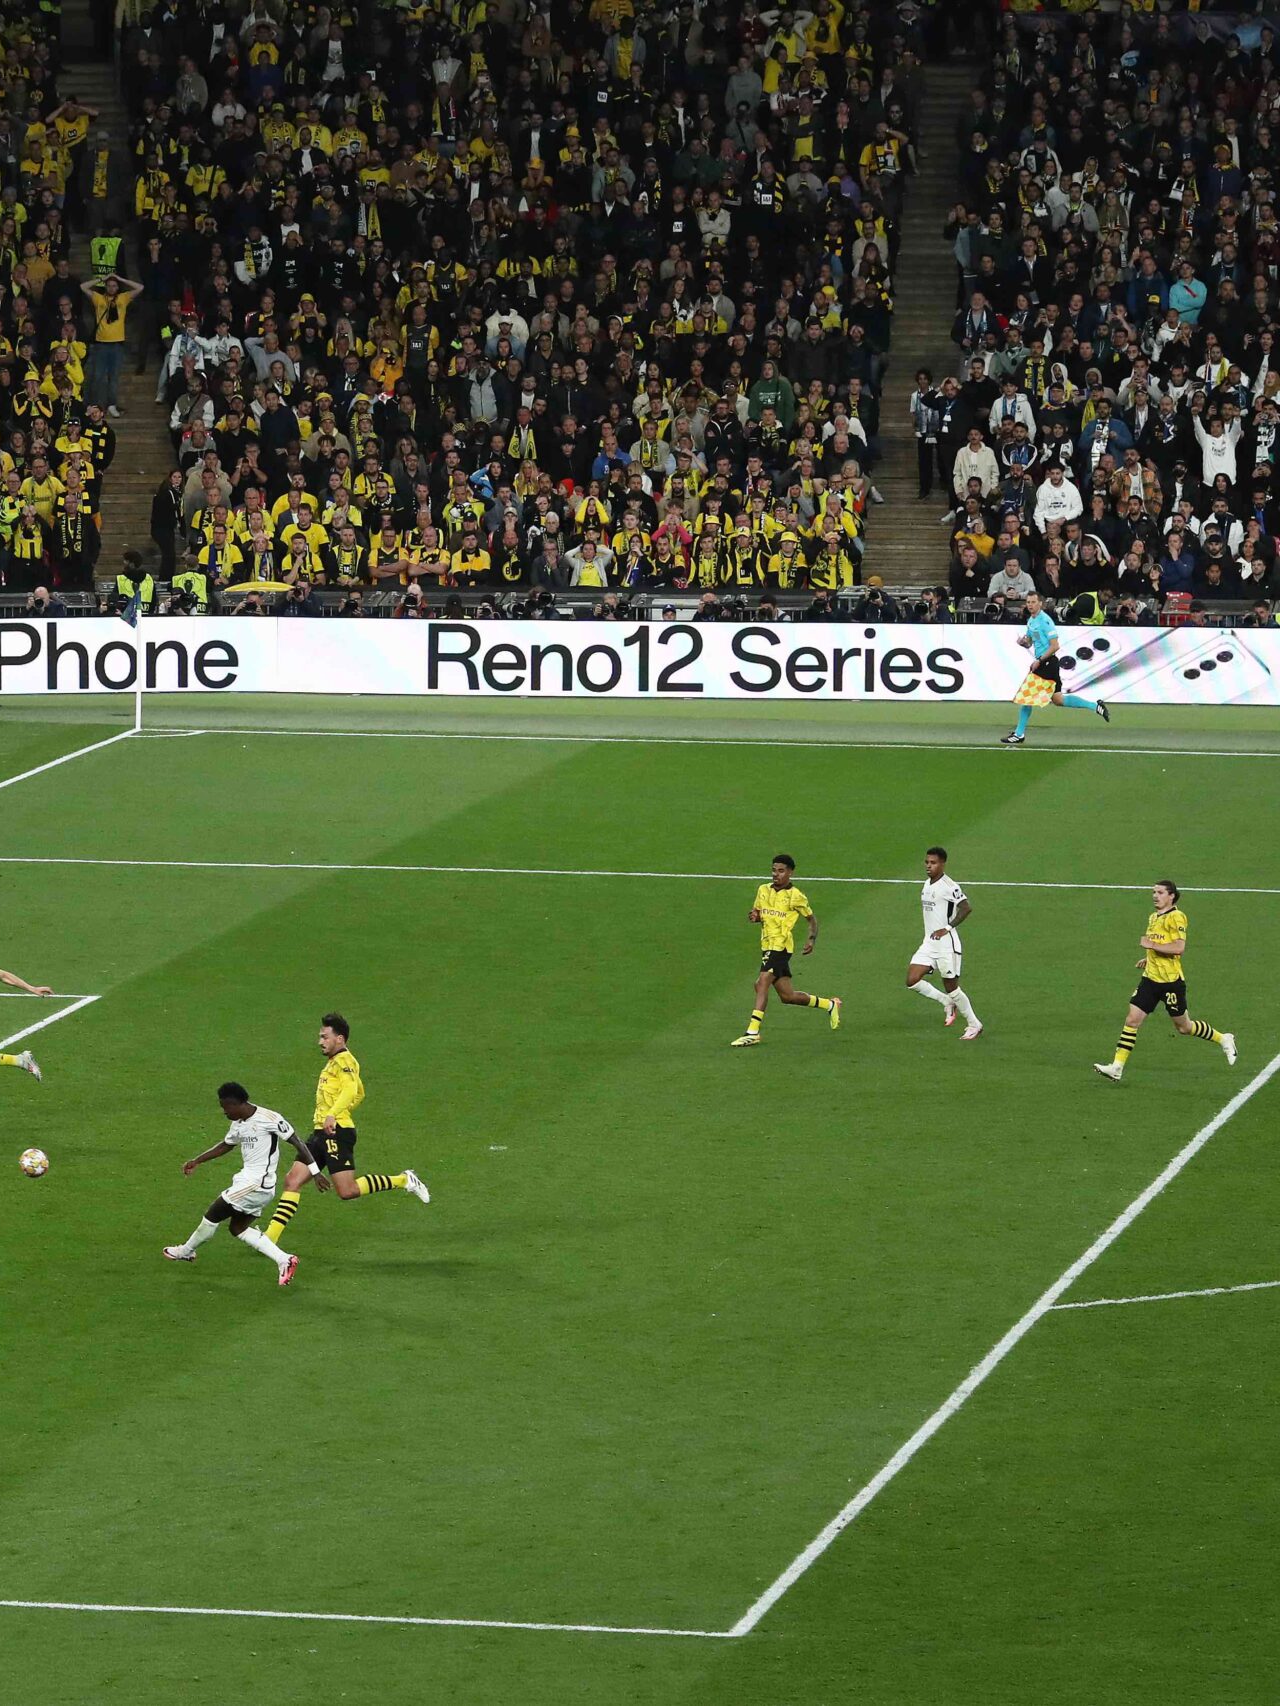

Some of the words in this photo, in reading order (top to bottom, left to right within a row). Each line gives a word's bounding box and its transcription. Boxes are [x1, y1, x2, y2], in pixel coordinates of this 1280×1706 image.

[428, 622, 704, 693] Reno12
[730, 624, 964, 694] Series
[1165, 992, 1178, 1005] 20
[325, 1138, 338, 1154] 15
